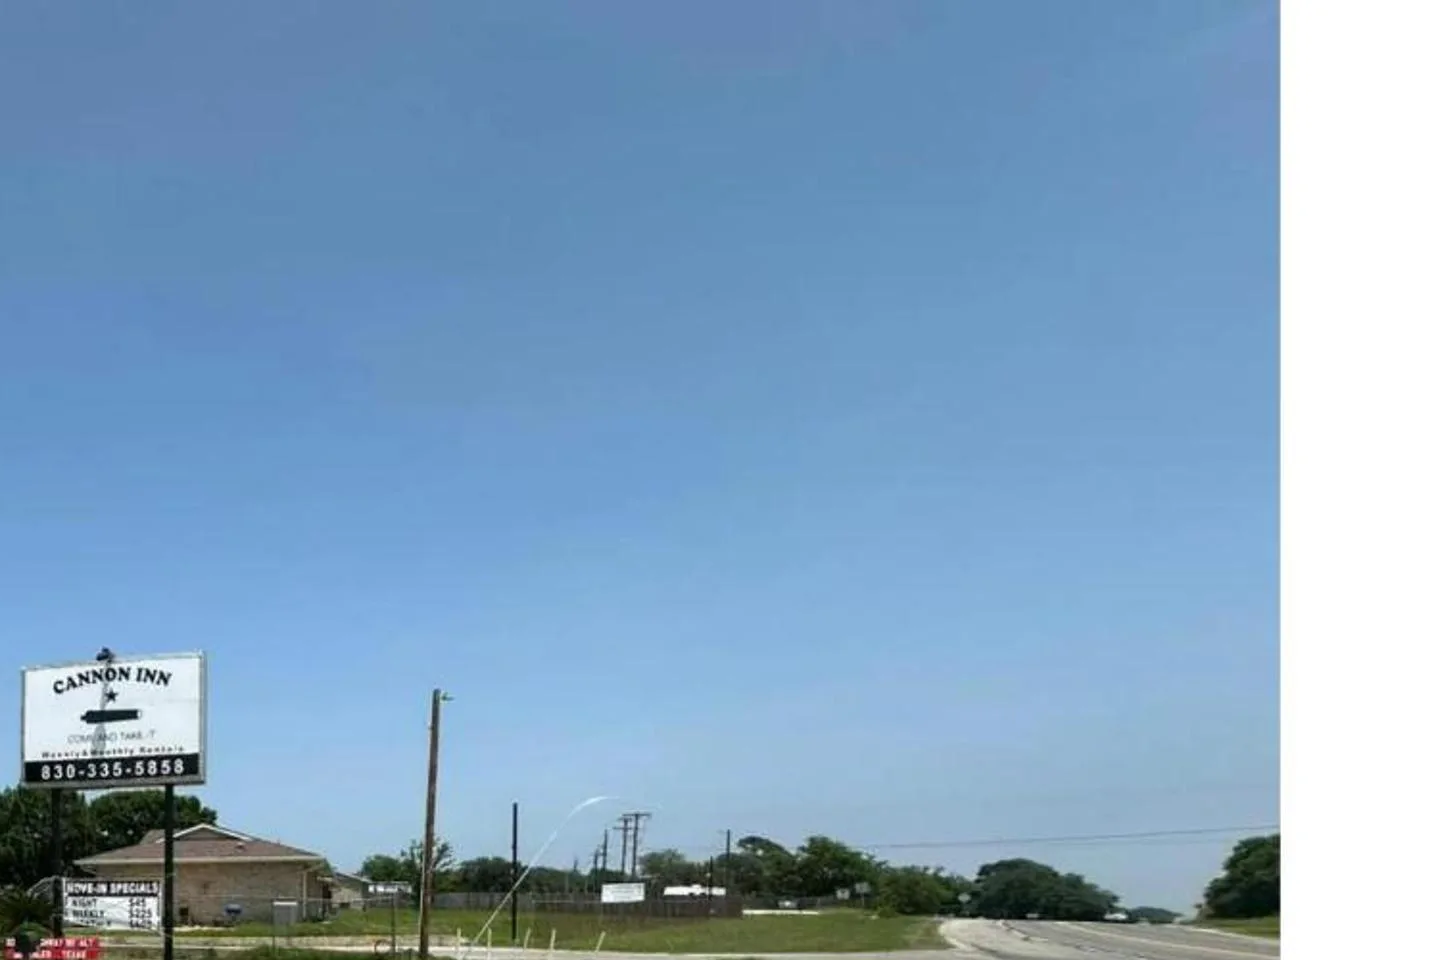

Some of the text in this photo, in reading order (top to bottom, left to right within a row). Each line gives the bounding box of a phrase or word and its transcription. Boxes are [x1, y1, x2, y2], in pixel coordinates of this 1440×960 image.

[53, 667, 172, 694] CANNON INN
[41, 758, 185, 780] 830-335-5858
[110, 883, 158, 894] SPECIALS
[72, 910, 105, 918] WEEKLY
